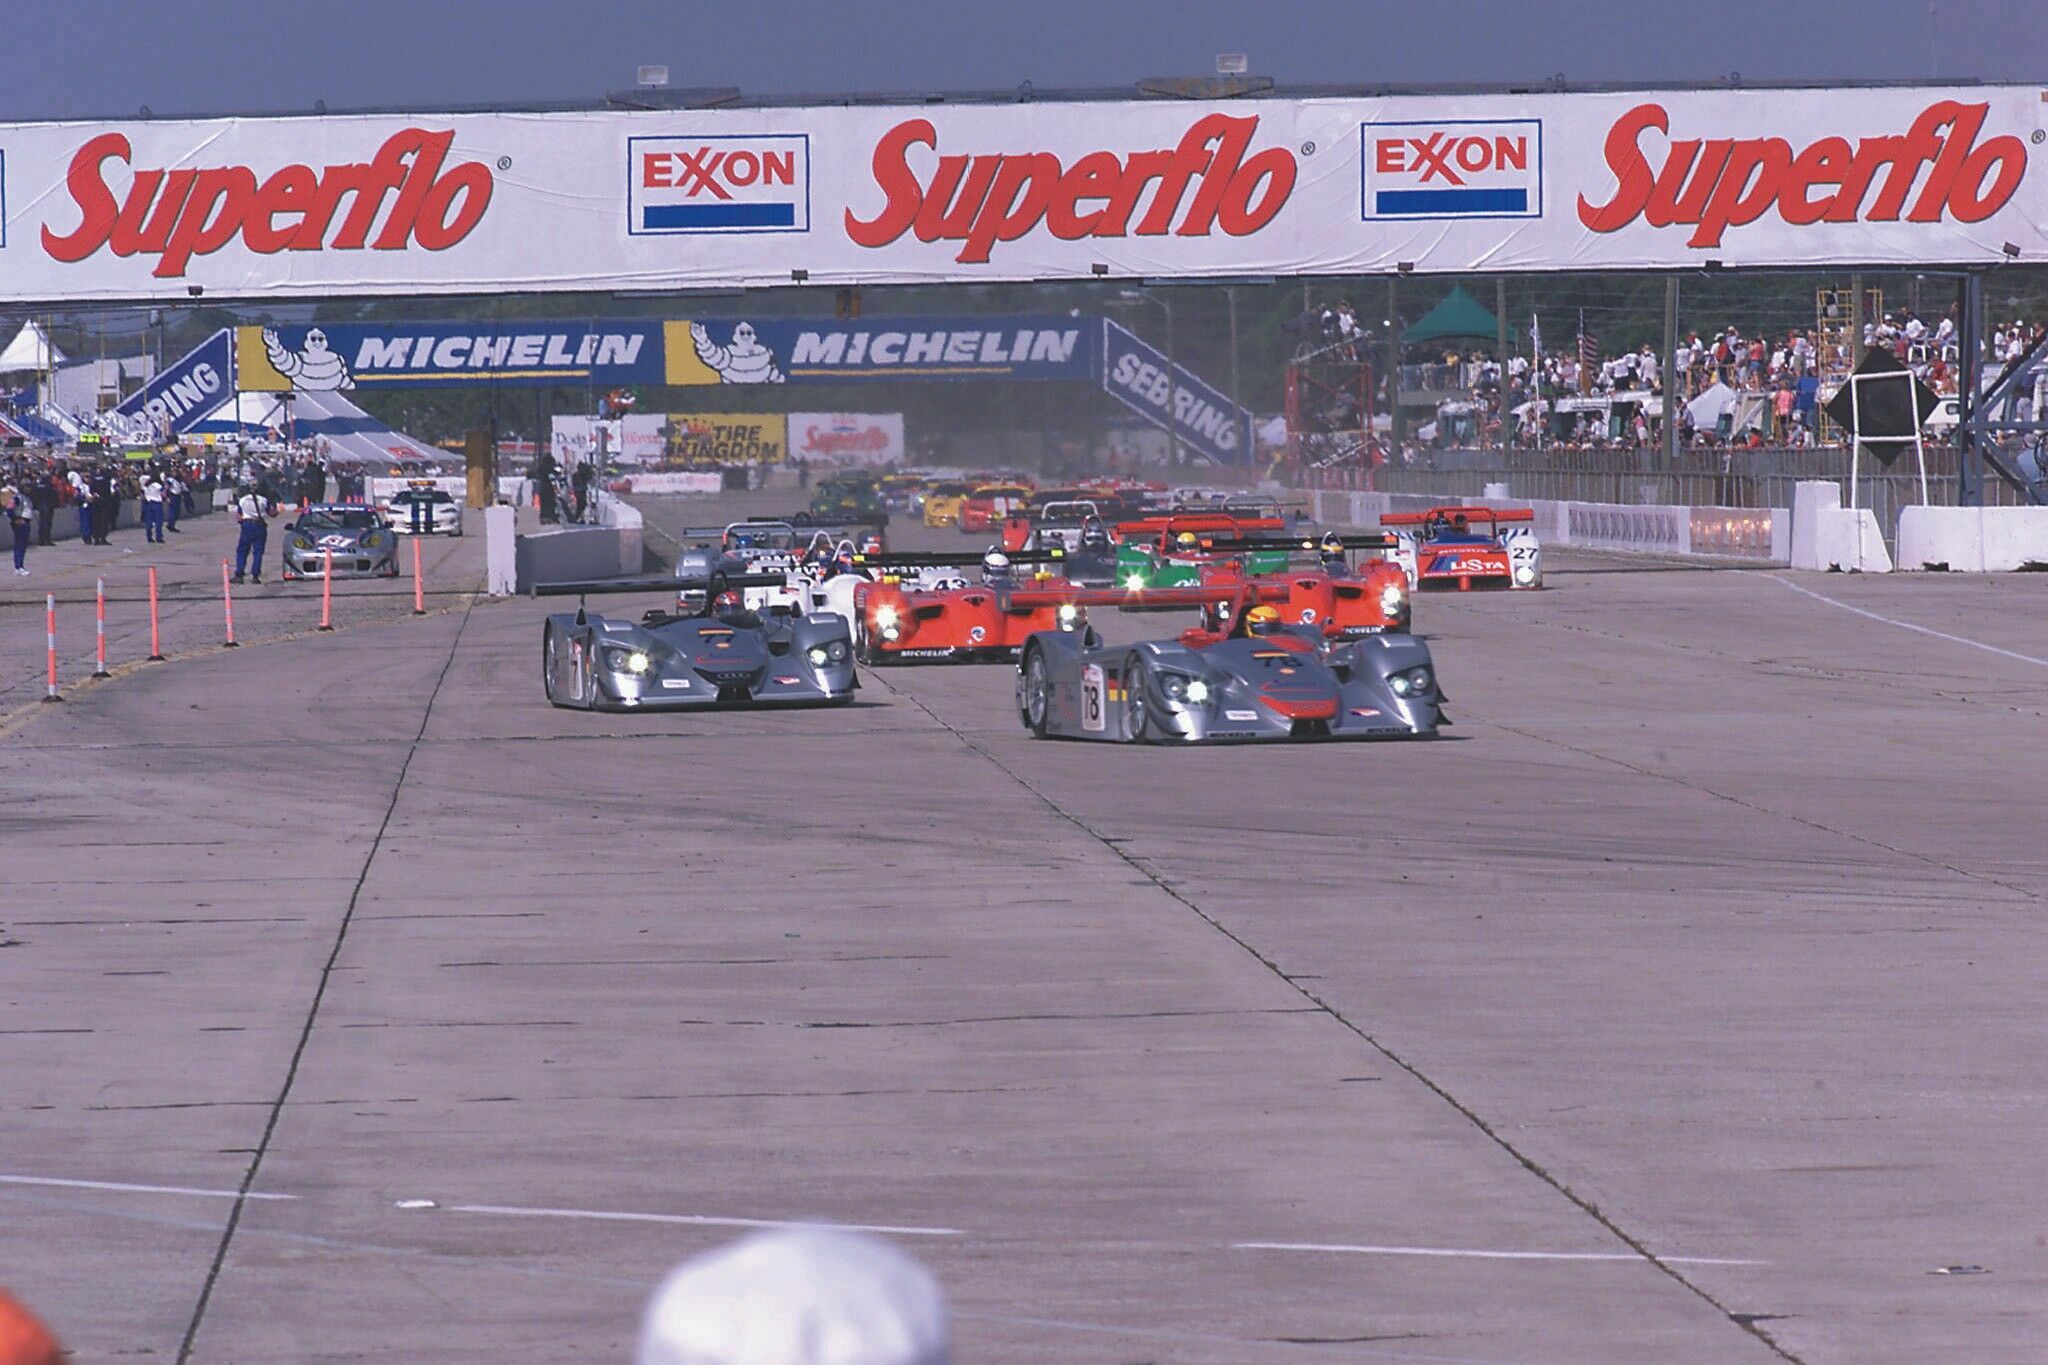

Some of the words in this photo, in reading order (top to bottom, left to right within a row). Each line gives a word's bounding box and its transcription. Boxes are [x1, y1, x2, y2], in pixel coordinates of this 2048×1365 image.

[643, 147, 794, 199] EXXON
[1376, 132, 1527, 186] EXXON
[1577, 100, 2028, 248] Superflo
[42, 127, 494, 277] Superflo
[845, 113, 1297, 262] Superflo
[354, 334, 644, 368] MICHELIN
[791, 330, 1079, 364] MICHELIN
[1112, 353, 1239, 450] SEBRING
[713, 425, 762, 441] TIRE
[1450, 558, 1506, 572] LISTA
[1514, 548, 1538, 560] 27
[900, 649, 950, 658] MICHELIN
[1083, 685, 1099, 721] 78
